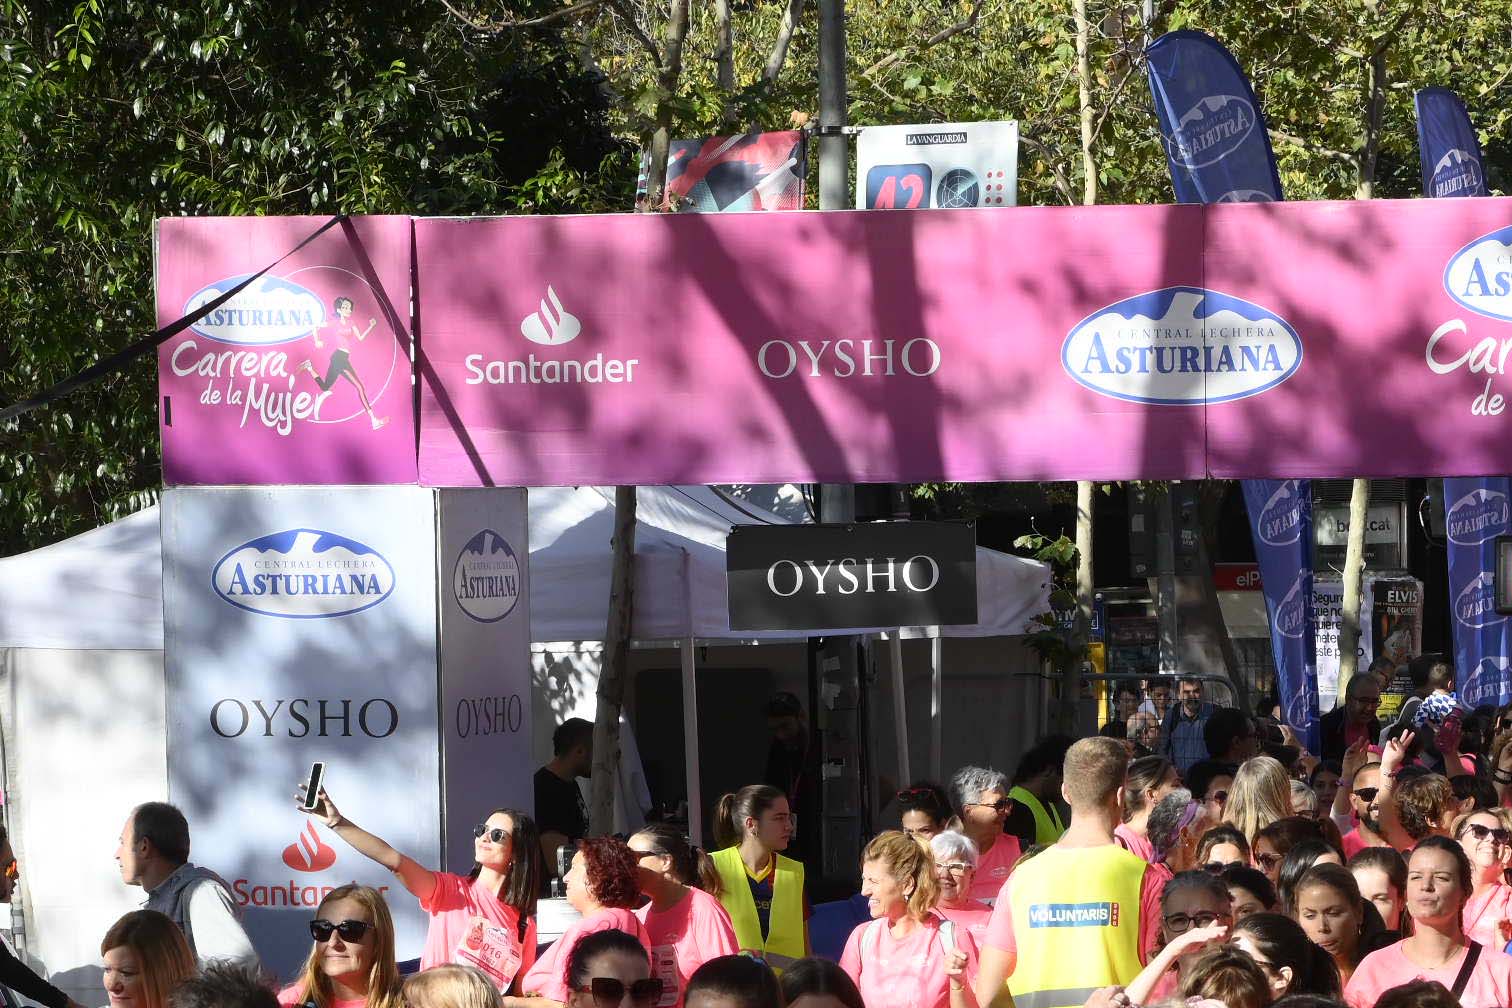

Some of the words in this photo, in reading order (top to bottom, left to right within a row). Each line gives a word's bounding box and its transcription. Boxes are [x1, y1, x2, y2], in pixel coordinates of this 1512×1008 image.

[918, 132, 966, 144] VANGUARDIA
[195, 302, 313, 327] ASTURIANA
[1117, 327, 1192, 340] CENTRAL
[1199, 326, 1276, 339] LECHERA
[171, 340, 288, 378] Carrera
[465, 352, 640, 385] Santander
[757, 337, 942, 379] OYSHO
[1080, 332, 1285, 376] ASTURIANA
[200, 379, 222, 405] de
[227, 377, 242, 405] la
[240, 374, 333, 436] Mujer
[1471, 378, 1506, 416] de
[226, 562, 382, 597] ASTURIANA
[254, 559, 312, 570] CENTRAL
[318, 558, 377, 569] LECHERA
[459, 563, 516, 600] ASTURIANA
[766, 555, 940, 598] OYSHO
[208, 698, 399, 738] OYSHO
[456, 694, 522, 739] OYSHO
[1031, 908, 1109, 922] VOLUNTARIS
